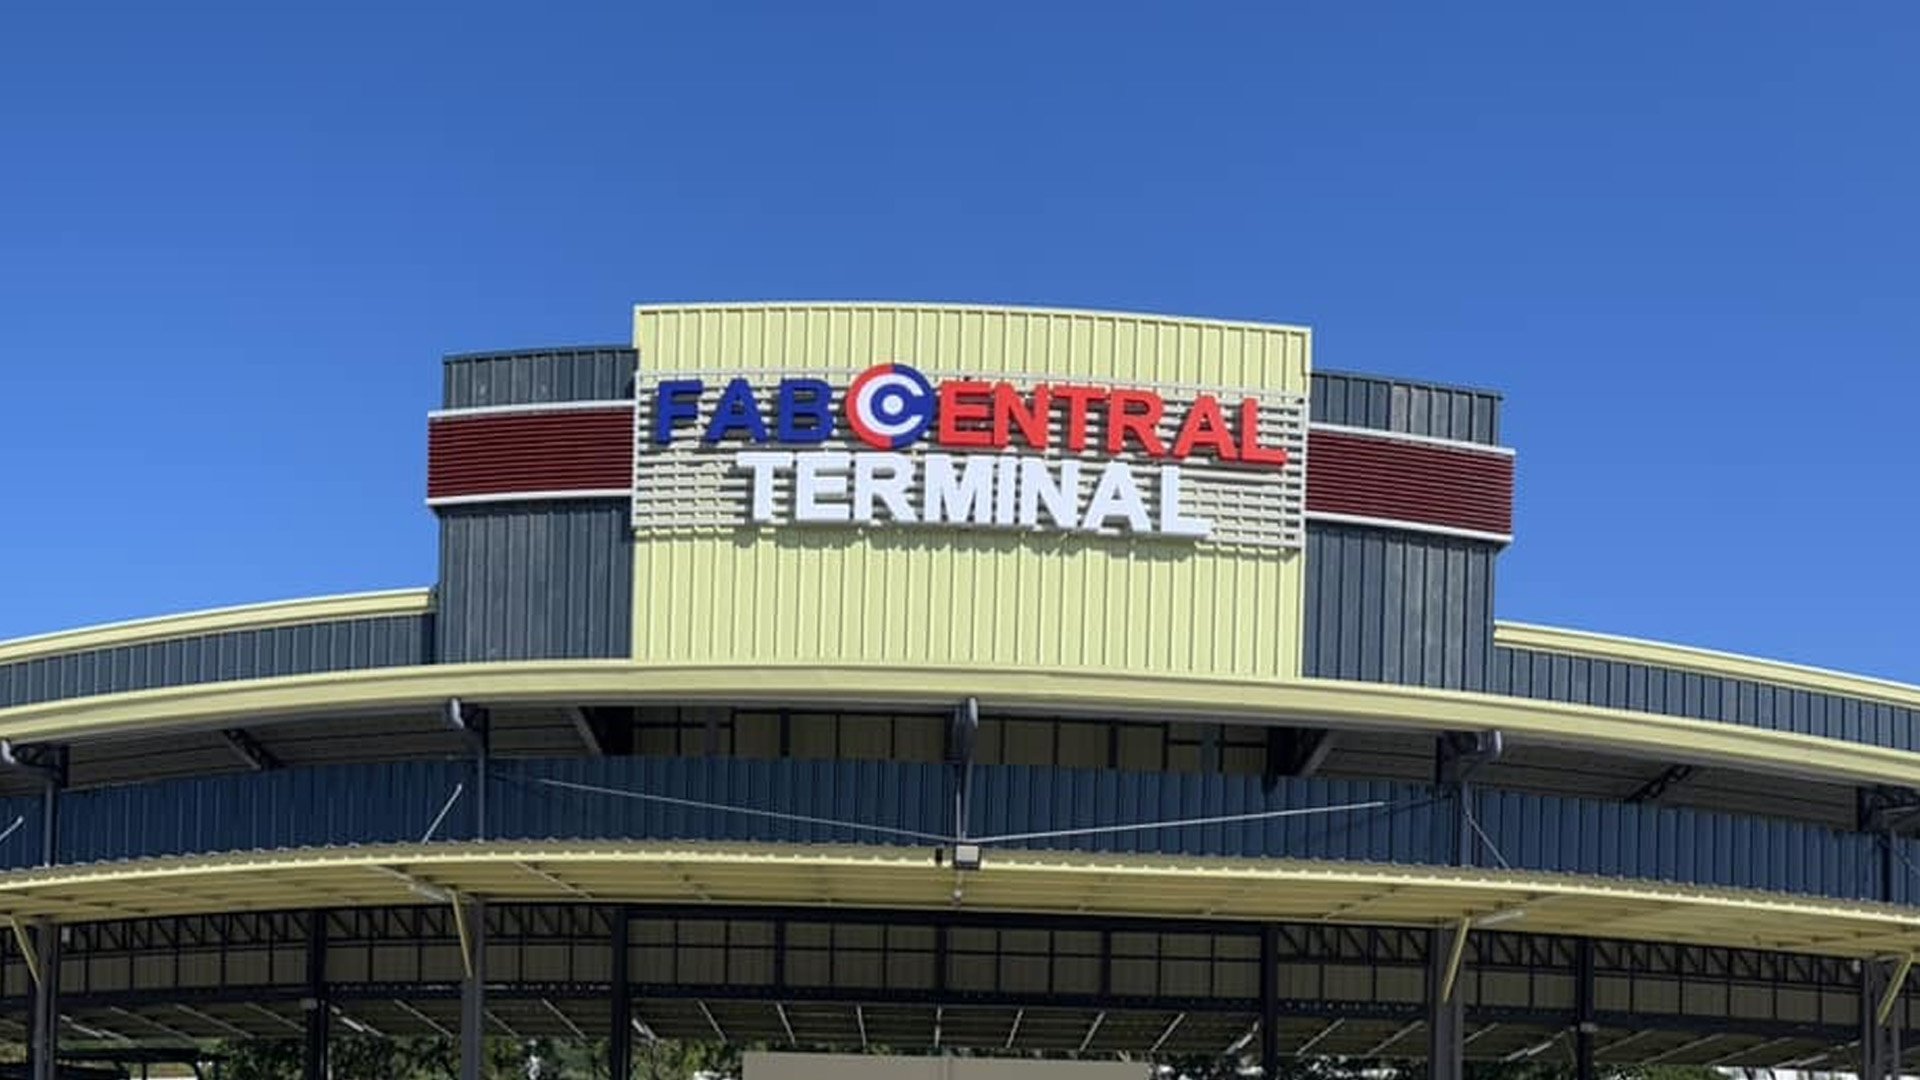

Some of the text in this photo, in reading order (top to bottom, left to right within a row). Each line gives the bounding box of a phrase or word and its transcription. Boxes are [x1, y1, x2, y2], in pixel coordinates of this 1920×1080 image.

[654, 362, 1288, 466] FAB CENTRAL
[736, 451, 1213, 538] TERMINAL
